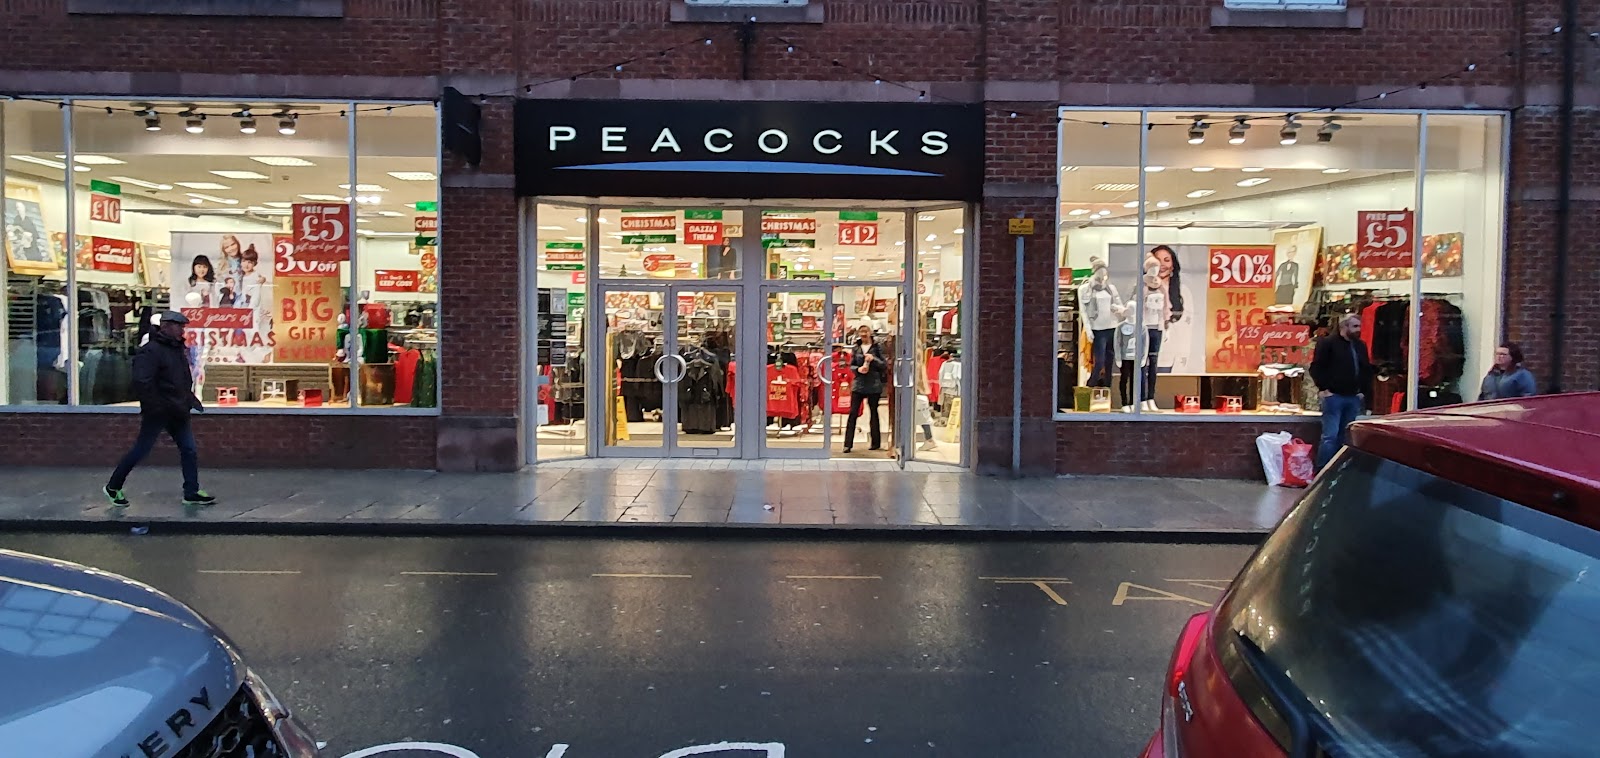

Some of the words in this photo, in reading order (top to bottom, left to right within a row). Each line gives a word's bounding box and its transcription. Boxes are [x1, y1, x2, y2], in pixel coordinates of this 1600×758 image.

[549, 126, 949, 156] PEACOCKS
[91, 200, 120, 222] £10
[1366, 213, 1387, 221] FREE
[299, 207, 344, 242] £5
[622, 218, 676, 228] CHRISTMAS
[689, 225, 718, 233] DAZZLE
[761, 222, 815, 231] CHRISTMAS
[1363, 213, 1408, 248] £5
[692, 233, 714, 241] THEM
[840, 225, 876, 244] £12
[317, 263, 337, 273] OFF
[1211, 253, 1273, 284] 30%
[1252, 274, 1272, 283] OFF
[291, 281, 322, 295] THE
[1226, 292, 1257, 306] THE
[282, 296, 333, 322] BIG
[183, 309, 204, 321] 135
[203, 313, 237, 328] years
[239, 310, 253, 326] of
[1216, 308, 1268, 332] BIG
[183, 330, 277, 347] RISTMAS
[289, 326, 326, 340] GIFT
[1240, 326, 1261, 339] 135
[1260, 330, 1292, 345] years
[1295, 327, 1309, 343] of
[121, 686, 211, 758] ERY
